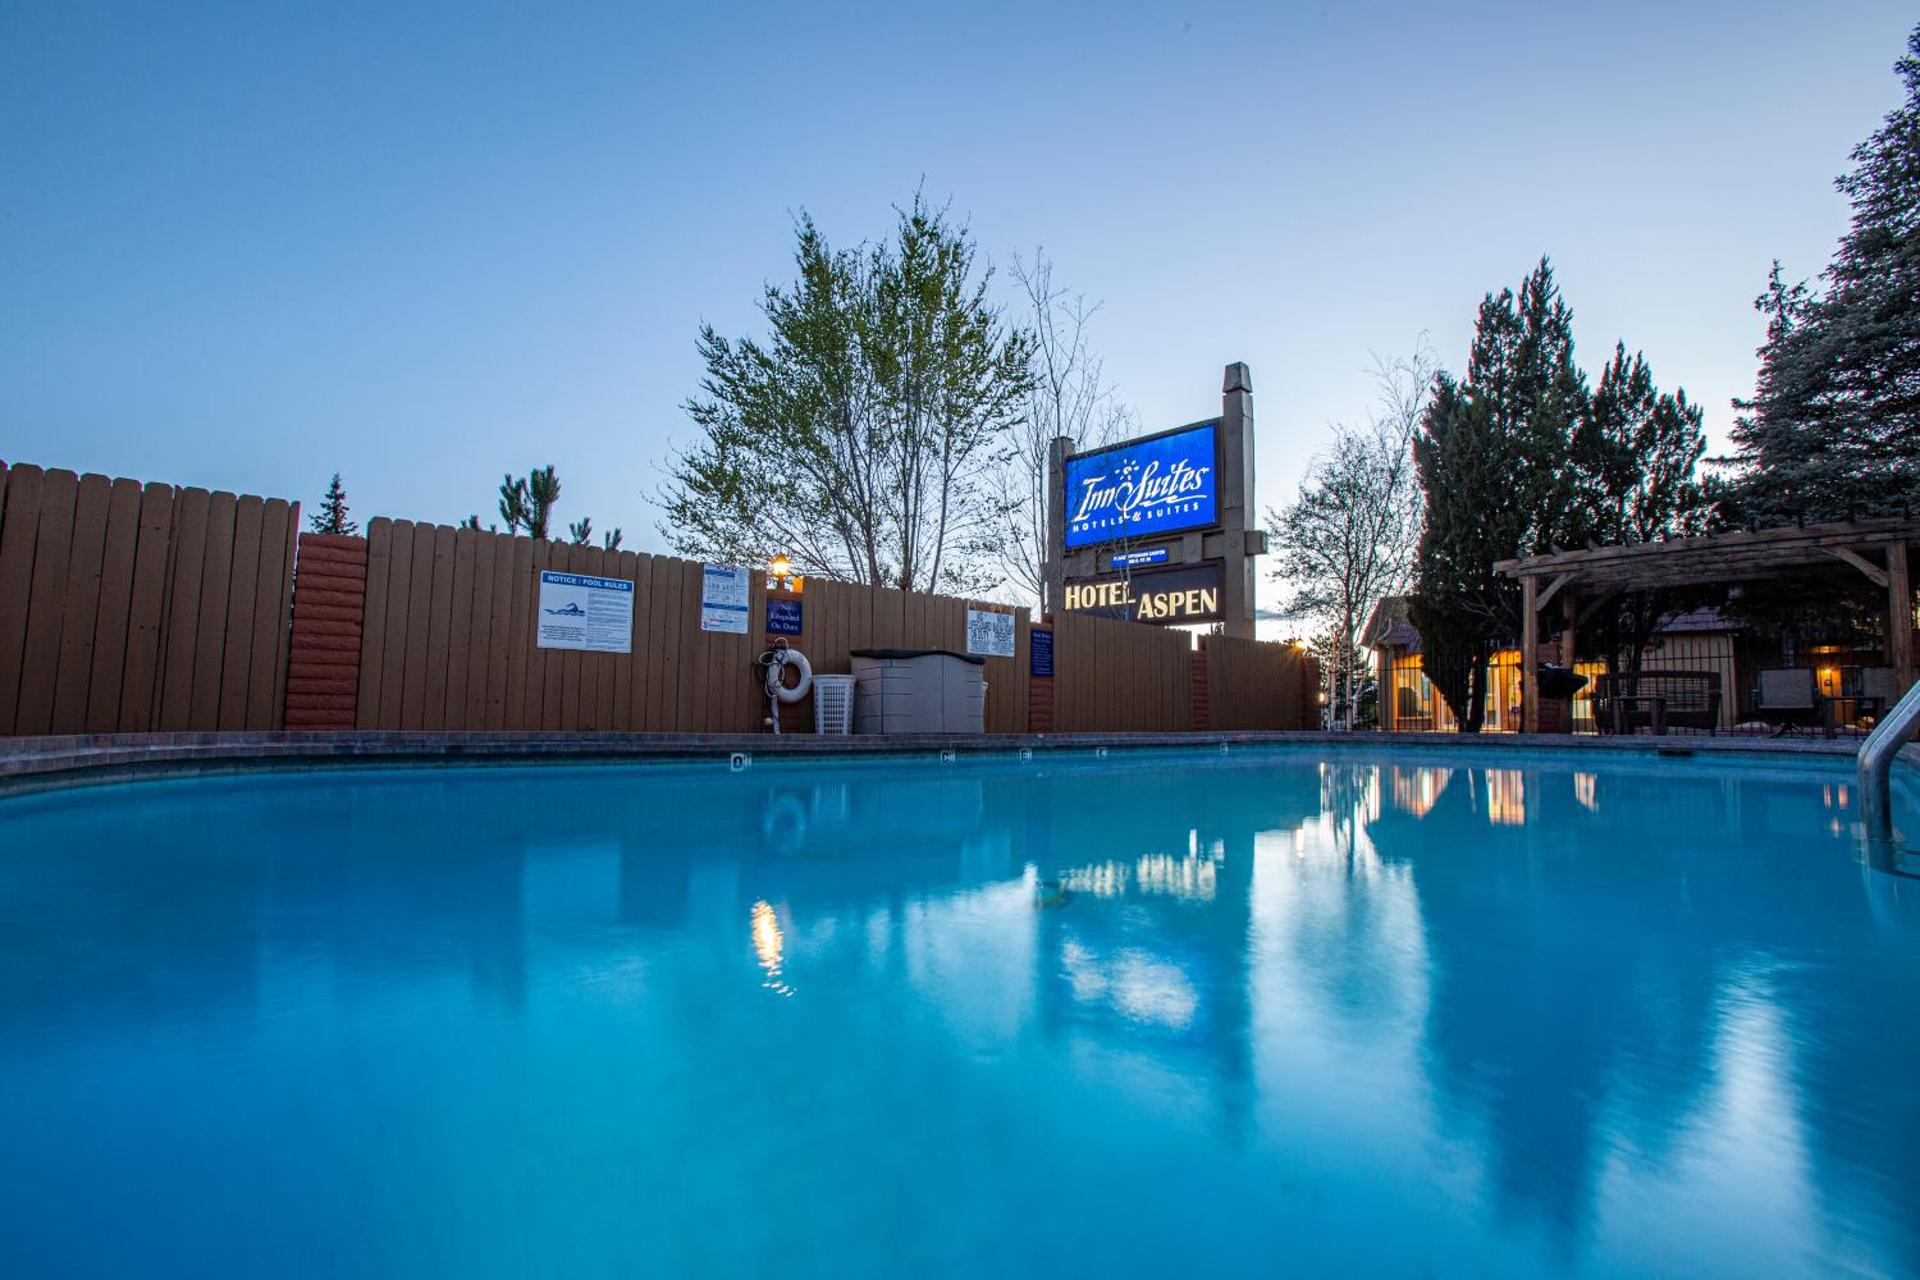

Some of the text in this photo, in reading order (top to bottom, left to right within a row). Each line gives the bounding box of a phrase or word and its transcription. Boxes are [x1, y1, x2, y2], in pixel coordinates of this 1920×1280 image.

[1073, 501, 1199, 533] HOTELS & SUITES
[548, 574, 577, 585] NOTICE
[582, 579, 603, 588] POOL
[604, 581, 628, 590] RULES
[1065, 581, 1217, 620] HOTEL ASPEN
